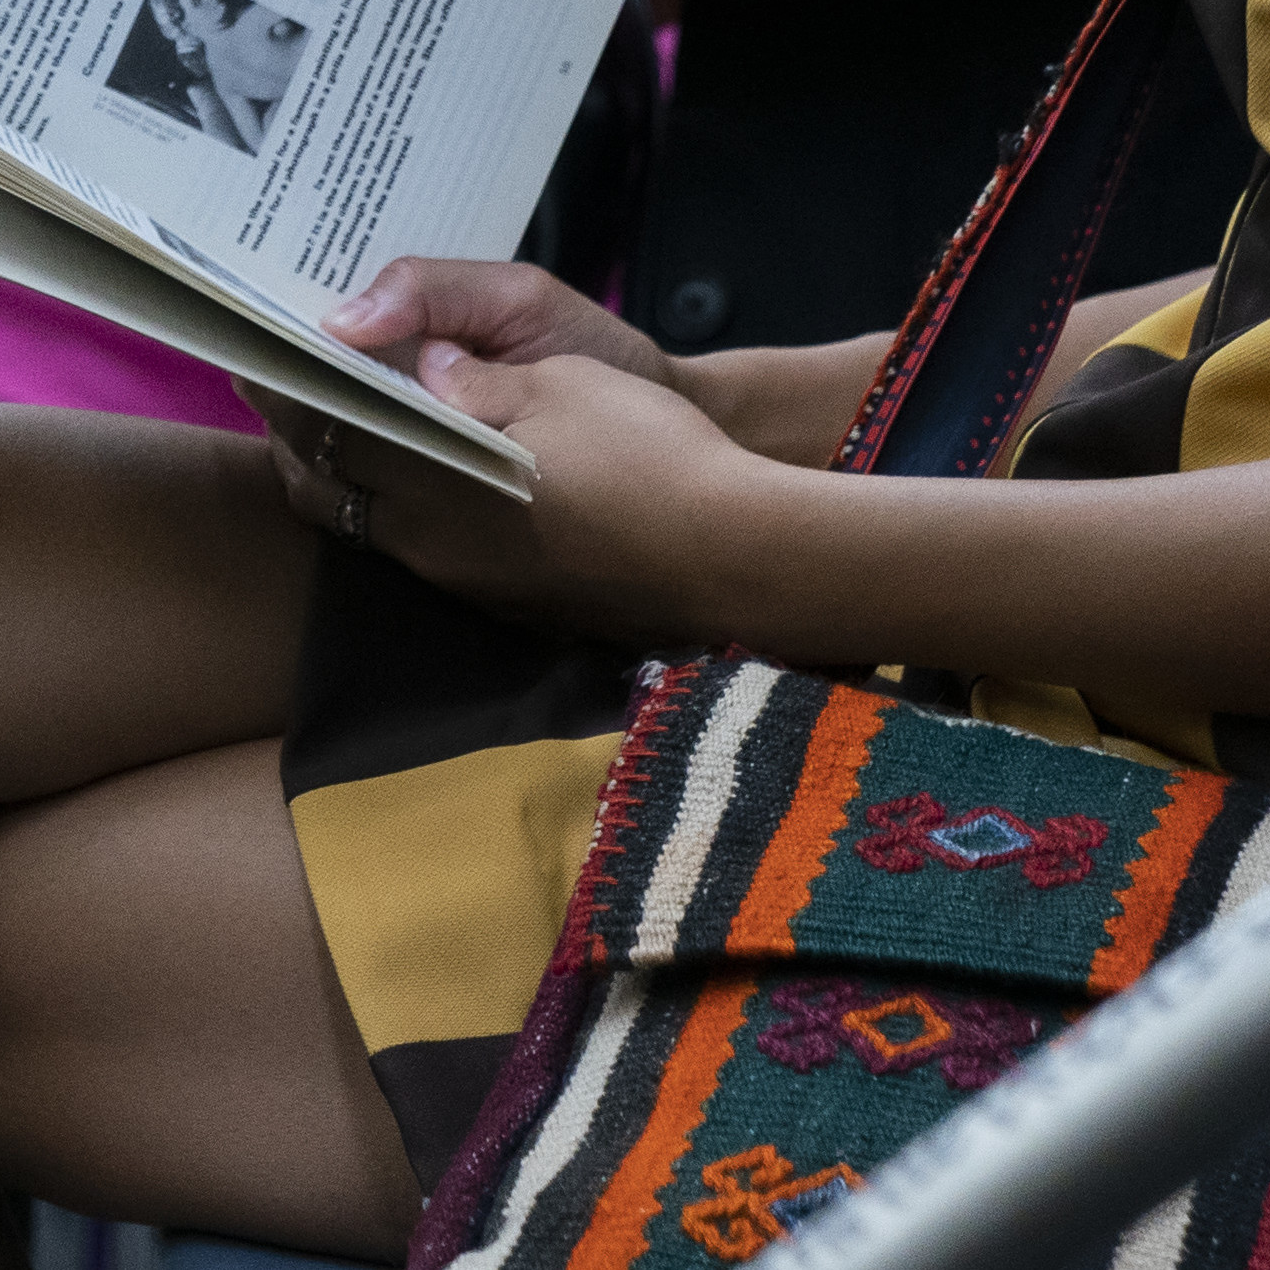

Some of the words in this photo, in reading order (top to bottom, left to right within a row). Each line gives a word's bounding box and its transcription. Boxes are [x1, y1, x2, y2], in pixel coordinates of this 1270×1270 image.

[15, 27, 39, 67] sexual
[31, 45, 50, 72] may
[43, 18, 61, 43] feel
[40, 69, 55, 90] are
[50, 35, 72, 67] there
[81, 22, 114, 77] Compare
[108, 0, 124, 21] the
[235, 221, 252, 245] one
[247, 199, 263, 219] the
[259, 158, 281, 198] model
[274, 137, 290, 157] for
[288, 80, 317, 126] famous
[311, 28, 340, 80] painting
[308, 217, 342, 281] calculated
[337, 178, 360, 217] charm
[361, 139, 376, 160] the
[372, 110, 389, 138] man
[384, 70, 406, 109] whom
[402, 46, 417, 69] she
[320, 266, 337, 288] her
[338, 201, 367, 255] although
[363, 176, 378, 199] she
[392, 92, 414, 128] know
[420, 37, 437, 61] She
[321, 152, 336, 176] not
[330, 130, 346, 152] the
[341, 63, 375, 130] expression
[323, 186, 339, 208] the
[334, 119, 367, 185] expression
[375, 46, 399, 91] woman
[250, 213, 273, 252] model
[267, 193, 283, 213] for
[283, 111, 319, 183] photograph
[372, 192, 388, 214] the
